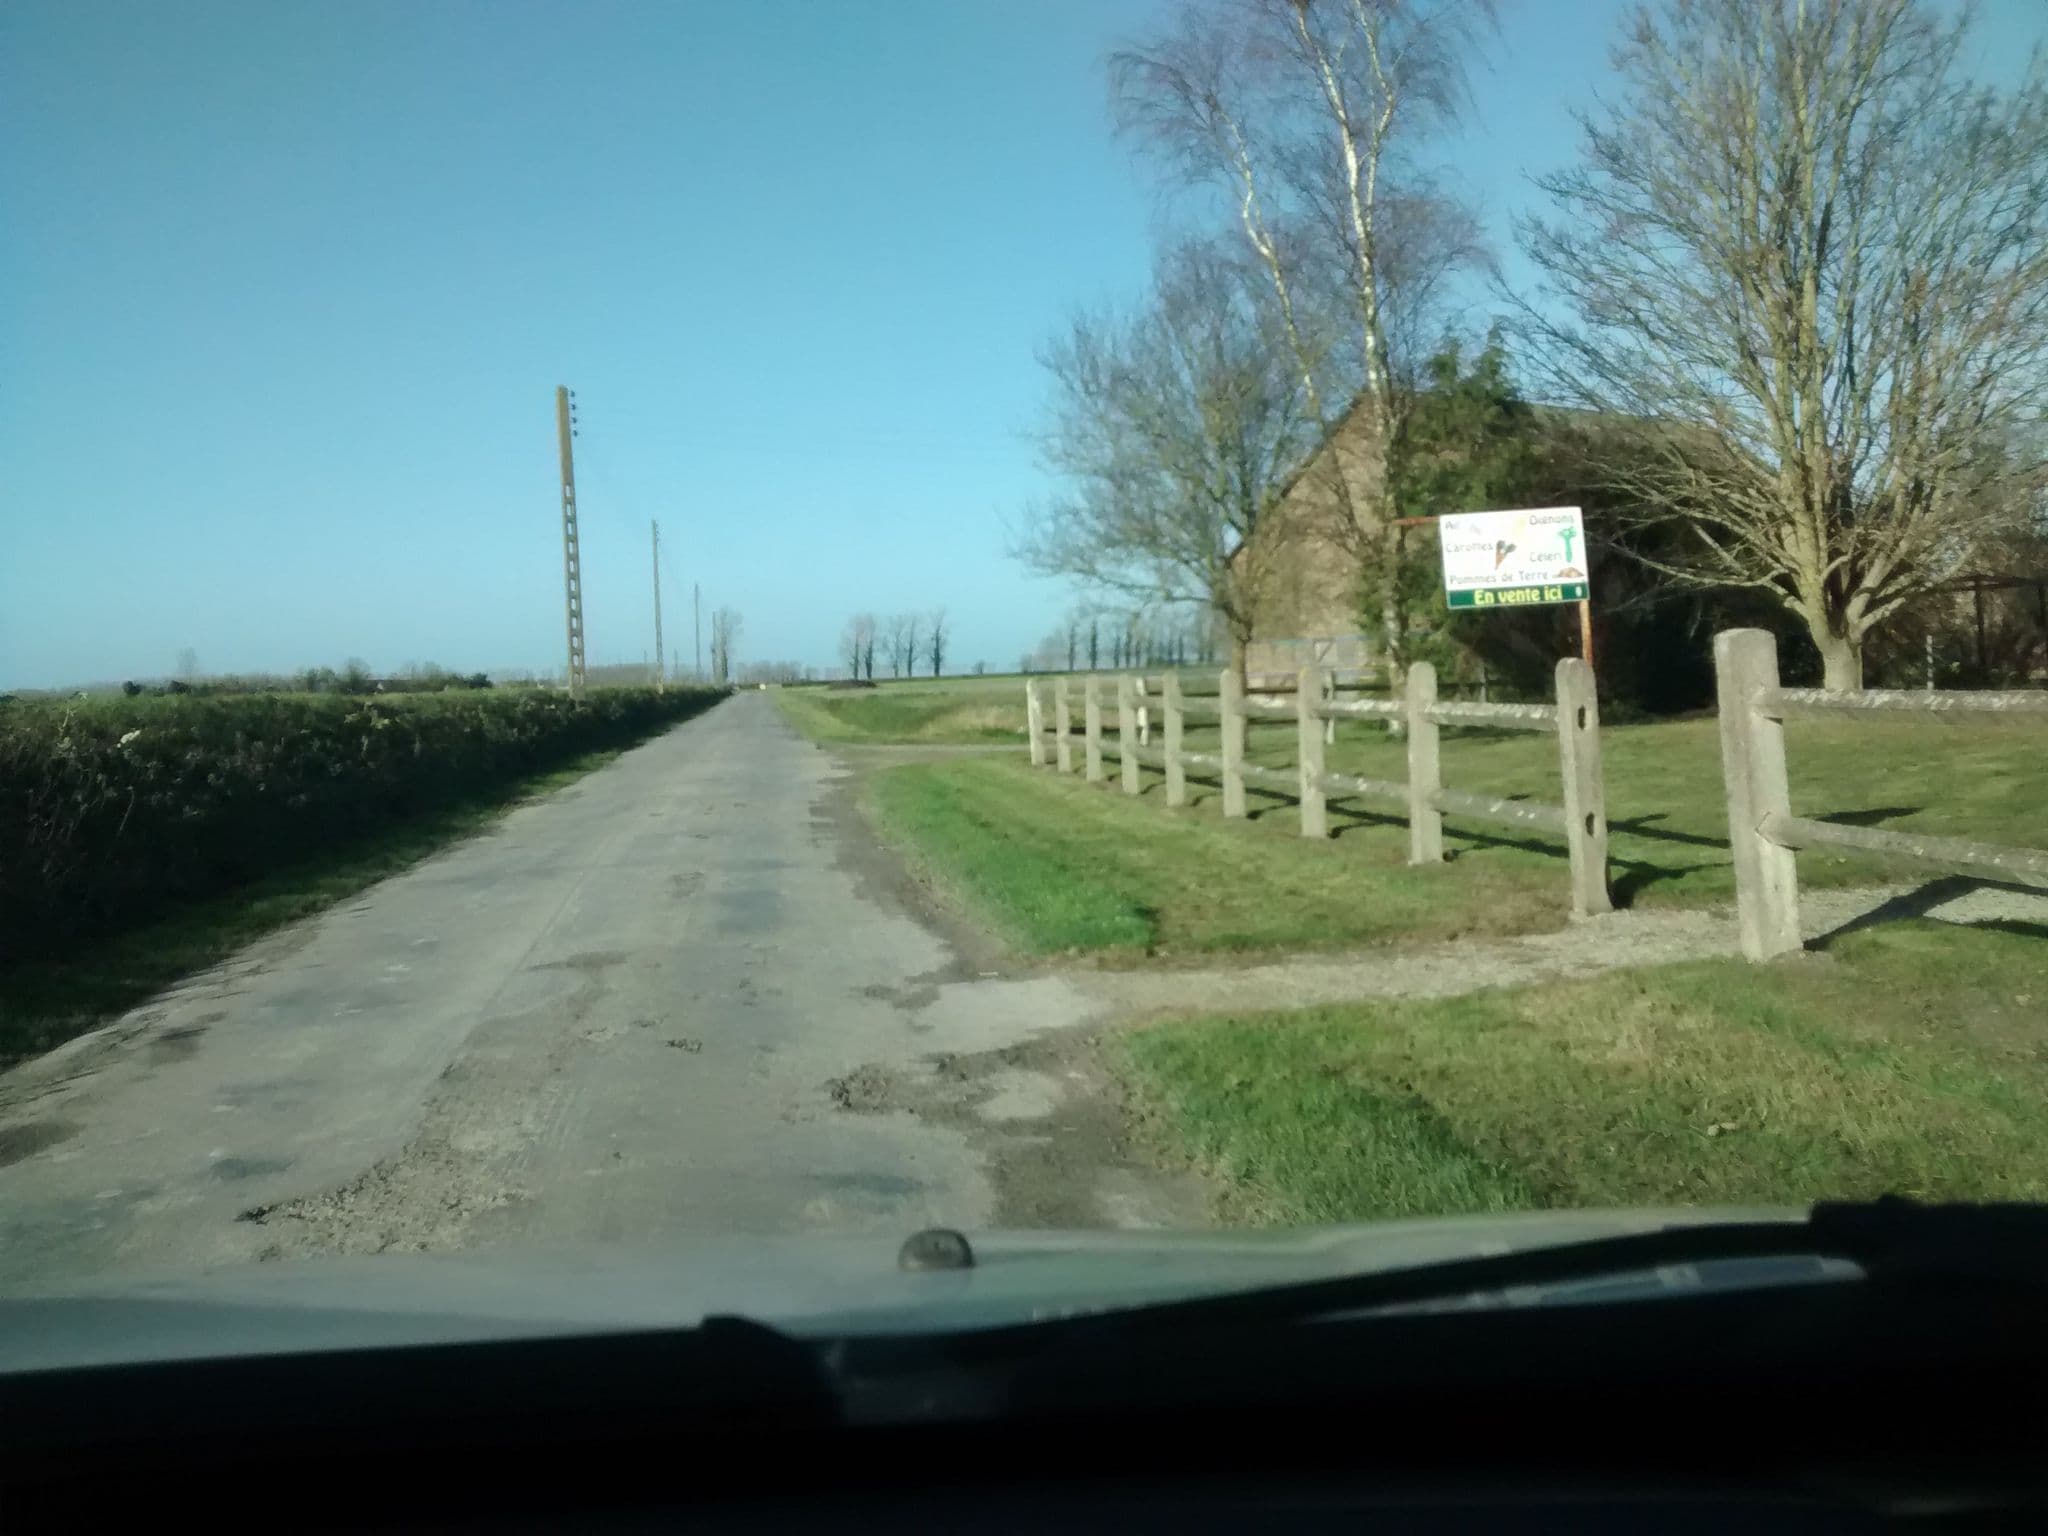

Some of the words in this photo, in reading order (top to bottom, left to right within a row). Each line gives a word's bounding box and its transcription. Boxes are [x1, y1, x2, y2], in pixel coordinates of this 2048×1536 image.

[1518, 570, 1549, 581] Terre
[1473, 588, 1495, 605] En
[1497, 586, 1541, 603] vente
[1544, 584, 1563, 601] ici
